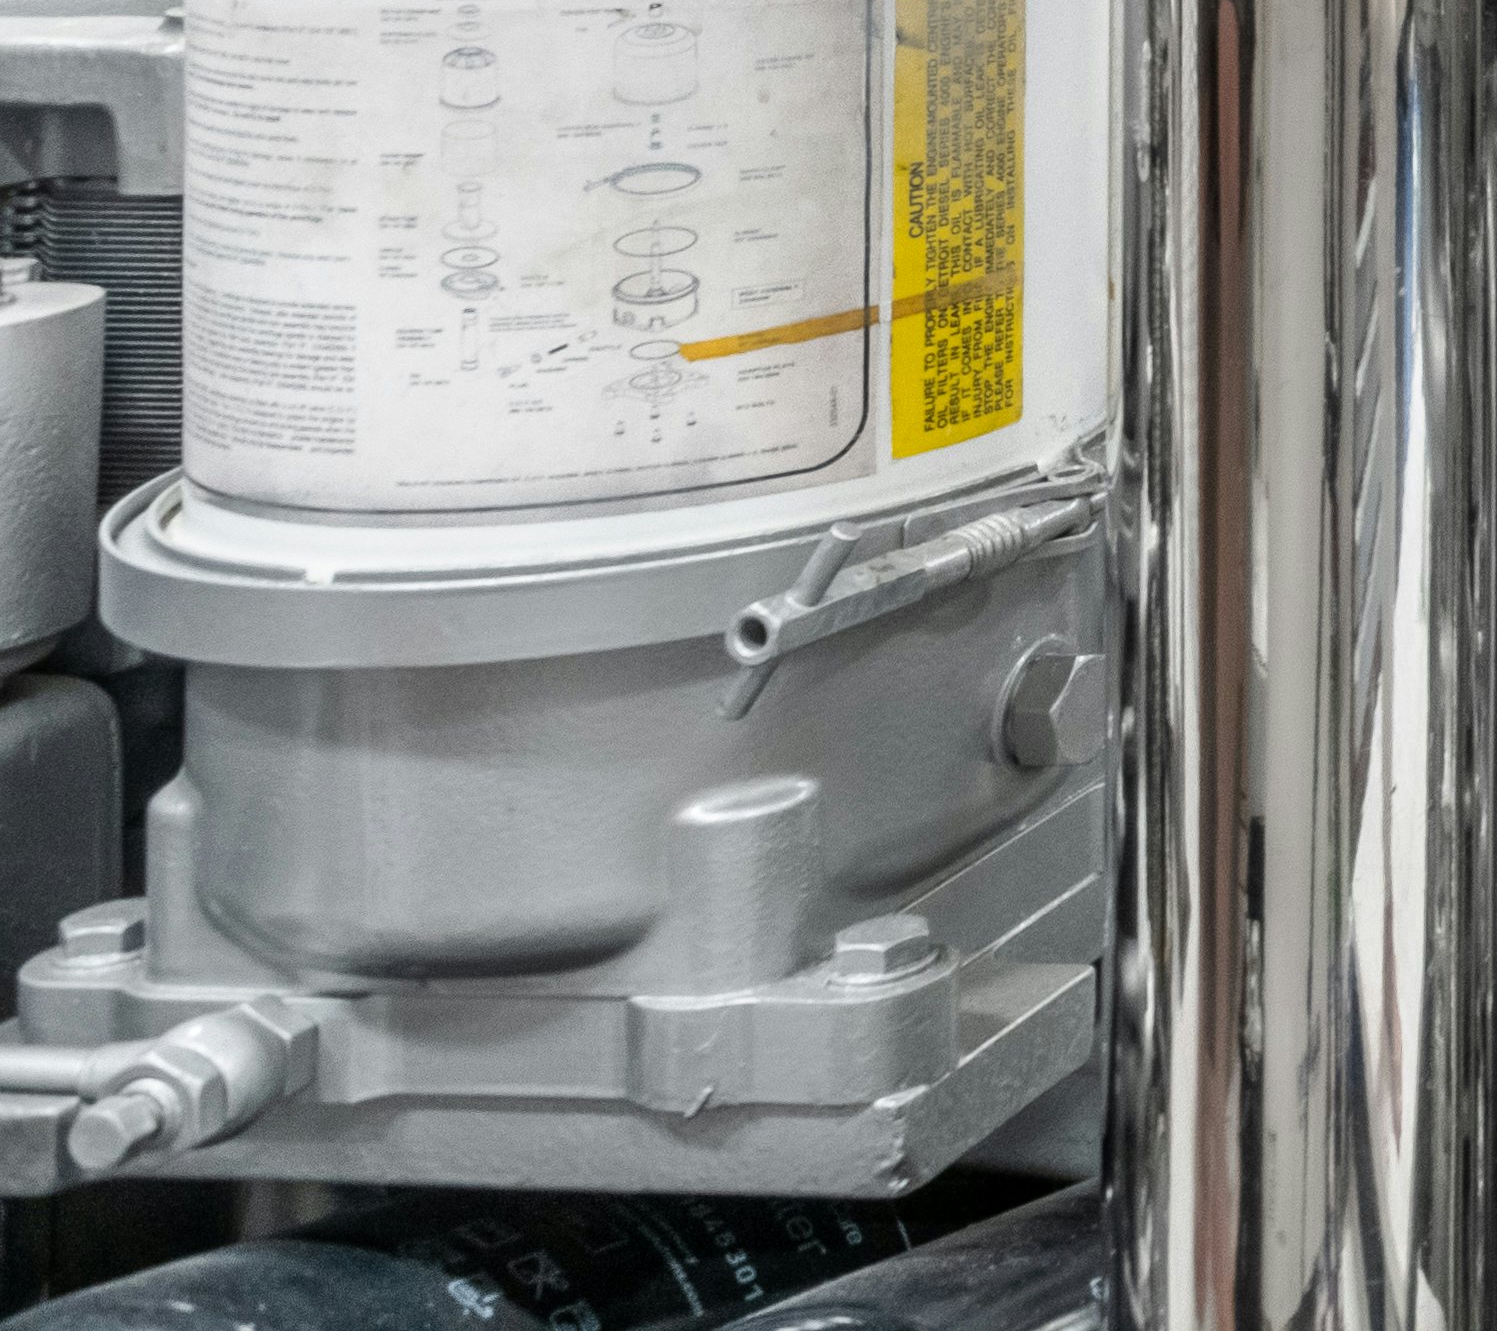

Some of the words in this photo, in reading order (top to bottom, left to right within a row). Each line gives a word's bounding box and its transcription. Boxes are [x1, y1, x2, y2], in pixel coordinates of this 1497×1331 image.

[953, 56, 962, 84] AND
[976, 65, 985, 99] LEAK
[975, 107, 985, 129] OIL
[986, 77, 996, 139] CORRECT
[939, 118, 949, 167] SERIES
[952, 98, 962, 178] FLAMMABLE
[963, 162, 972, 197] WITH
[986, 150, 994, 176] AND
[1007, 130, 1015, 209] INSTALLING
[909, 161, 923, 238] CAUTION
[927, 183, 936, 207] THE
[952, 189, 961, 201] IS
[975, 138, 985, 230] LUBRICATING
[939, 180, 949, 227] DIESEL
[996, 191, 1005, 238] SERIES
[951, 215, 961, 235] OIL
[963, 209, 972, 272] CONTACT
[975, 237, 983, 247] A
[986, 187, 995, 274] IMMEDIATELY
[1006, 225, 1015, 245] ON
[926, 215, 936, 271] TIGHTEN
[951, 245, 960, 276] THIS
[975, 255, 983, 267] IF
[938, 308, 948, 328] ON
[985, 283, 994, 333] ENGIN
[974, 320, 983, 359] FROM
[995, 308, 1004, 352] REFER
[925, 353, 934, 370] TO
[938, 339, 948, 395] FILTERS
[950, 346, 959, 359] IN
[962, 326, 972, 375] COMES
[985, 343, 993, 369] THE
[950, 372, 960, 424] RESULT
[962, 387, 971, 398] IT
[973, 369, 983, 418] INJURY
[984, 380, 994, 415] STOP
[995, 361, 1003, 411] PLEASE
[1005, 379, 1013, 408] FOR
[924, 378, 935, 432] FAILURE
[938, 405, 948, 428] OIL
[962, 409, 971, 421] IF
